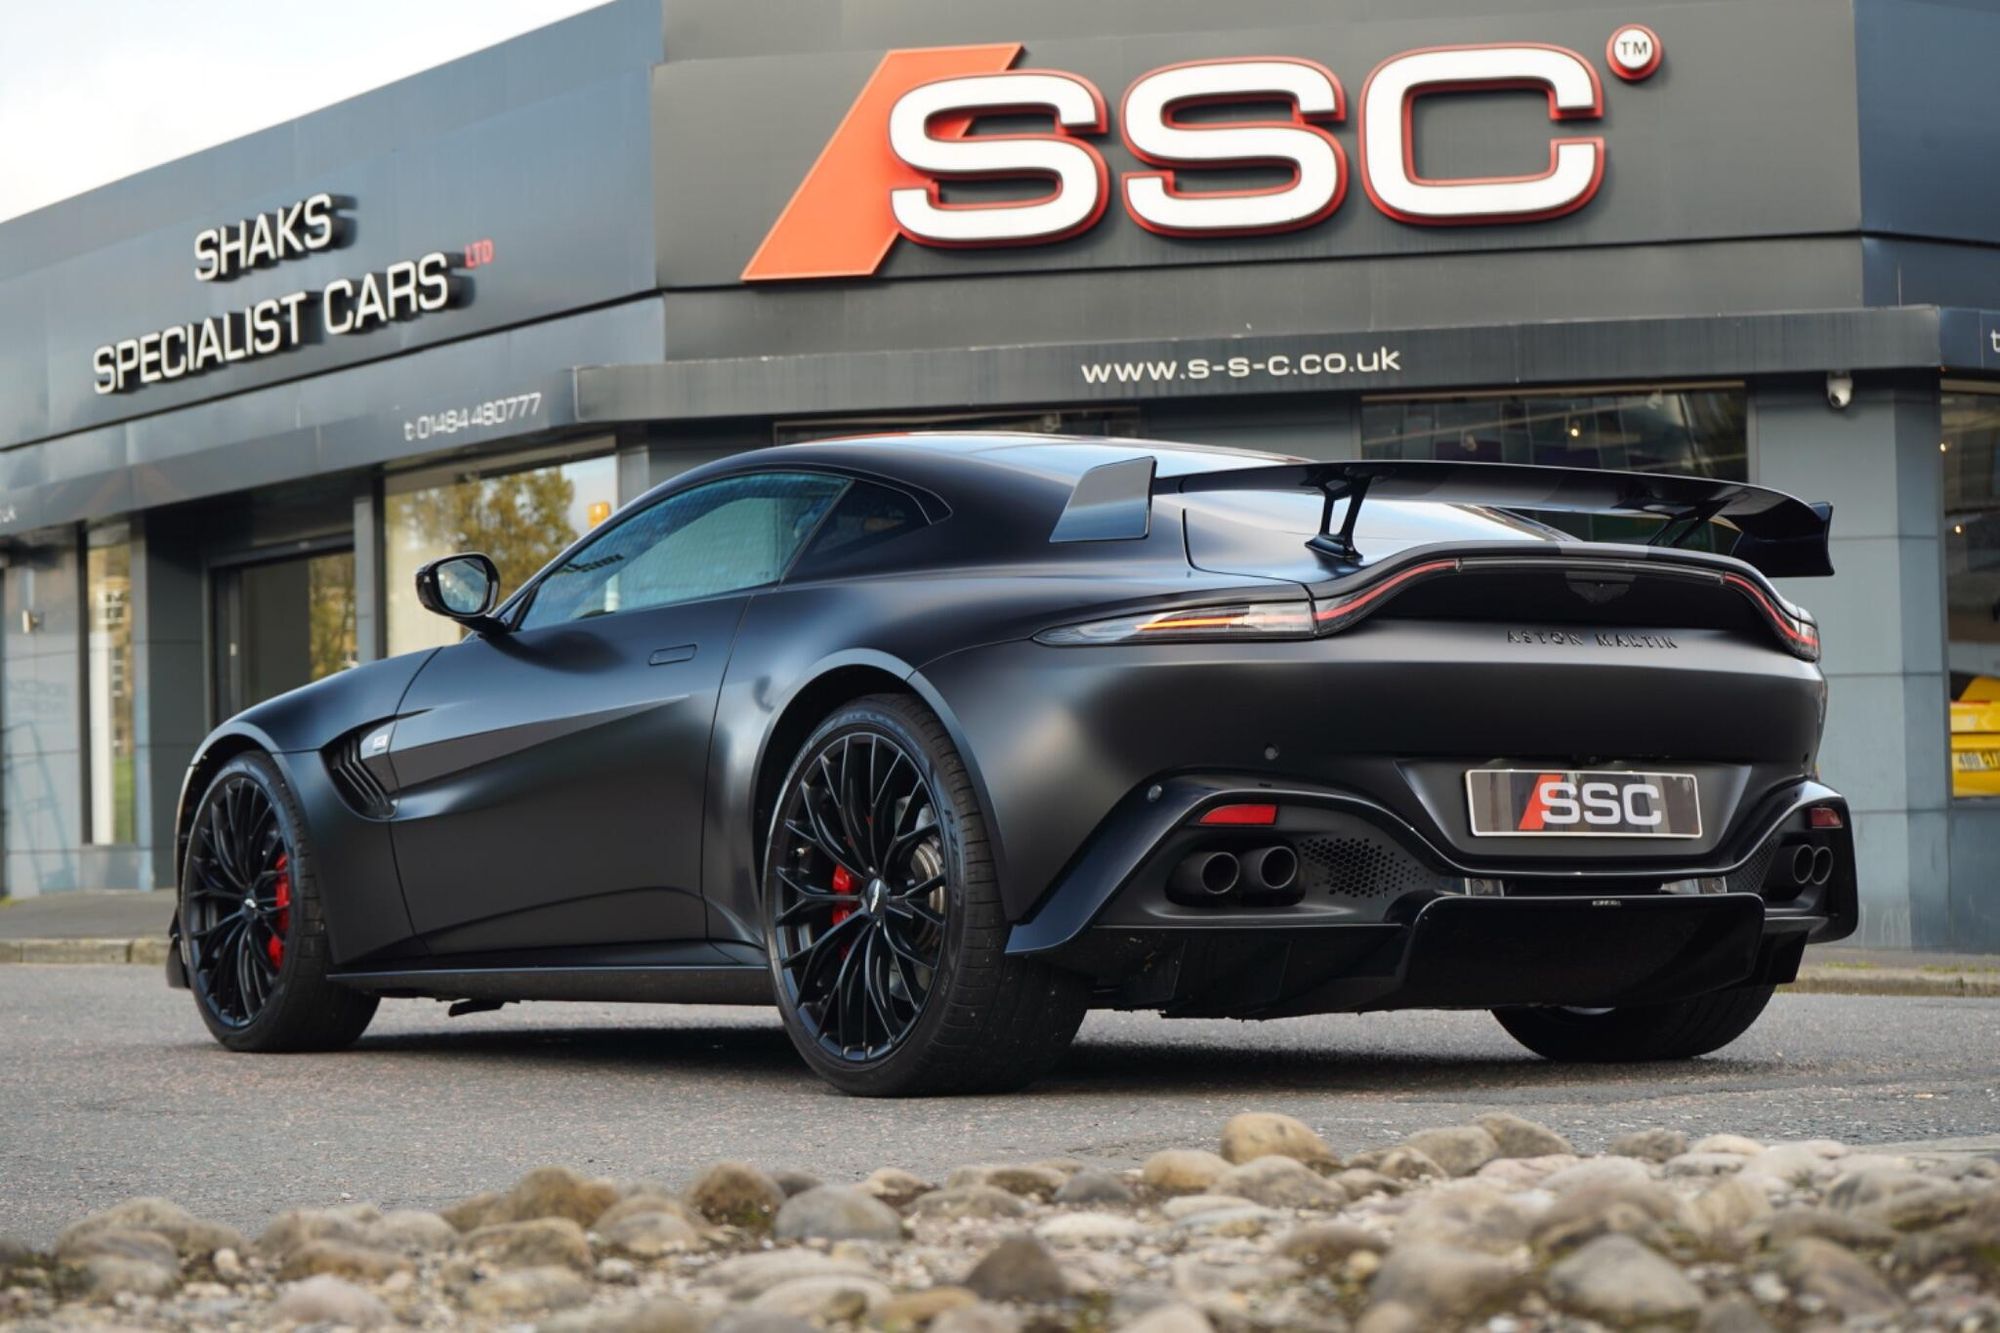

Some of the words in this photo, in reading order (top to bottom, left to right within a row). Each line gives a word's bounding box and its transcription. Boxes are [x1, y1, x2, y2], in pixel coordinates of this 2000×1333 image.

[1620, 41, 1648, 55] TM
[889, 43, 1602, 244] SSC
[194, 193, 334, 282] SHAKS
[93, 291, 307, 395] SPECIALIST
[322, 251, 450, 336] CARS
[465, 238, 494, 268] LTD
[1081, 346, 1401, 384] www.s-s-c.co.uk
[1507, 630, 1583, 646] ASTON
[1594, 632, 1679, 649] MARTIN
[1539, 781, 1662, 826] SSC
